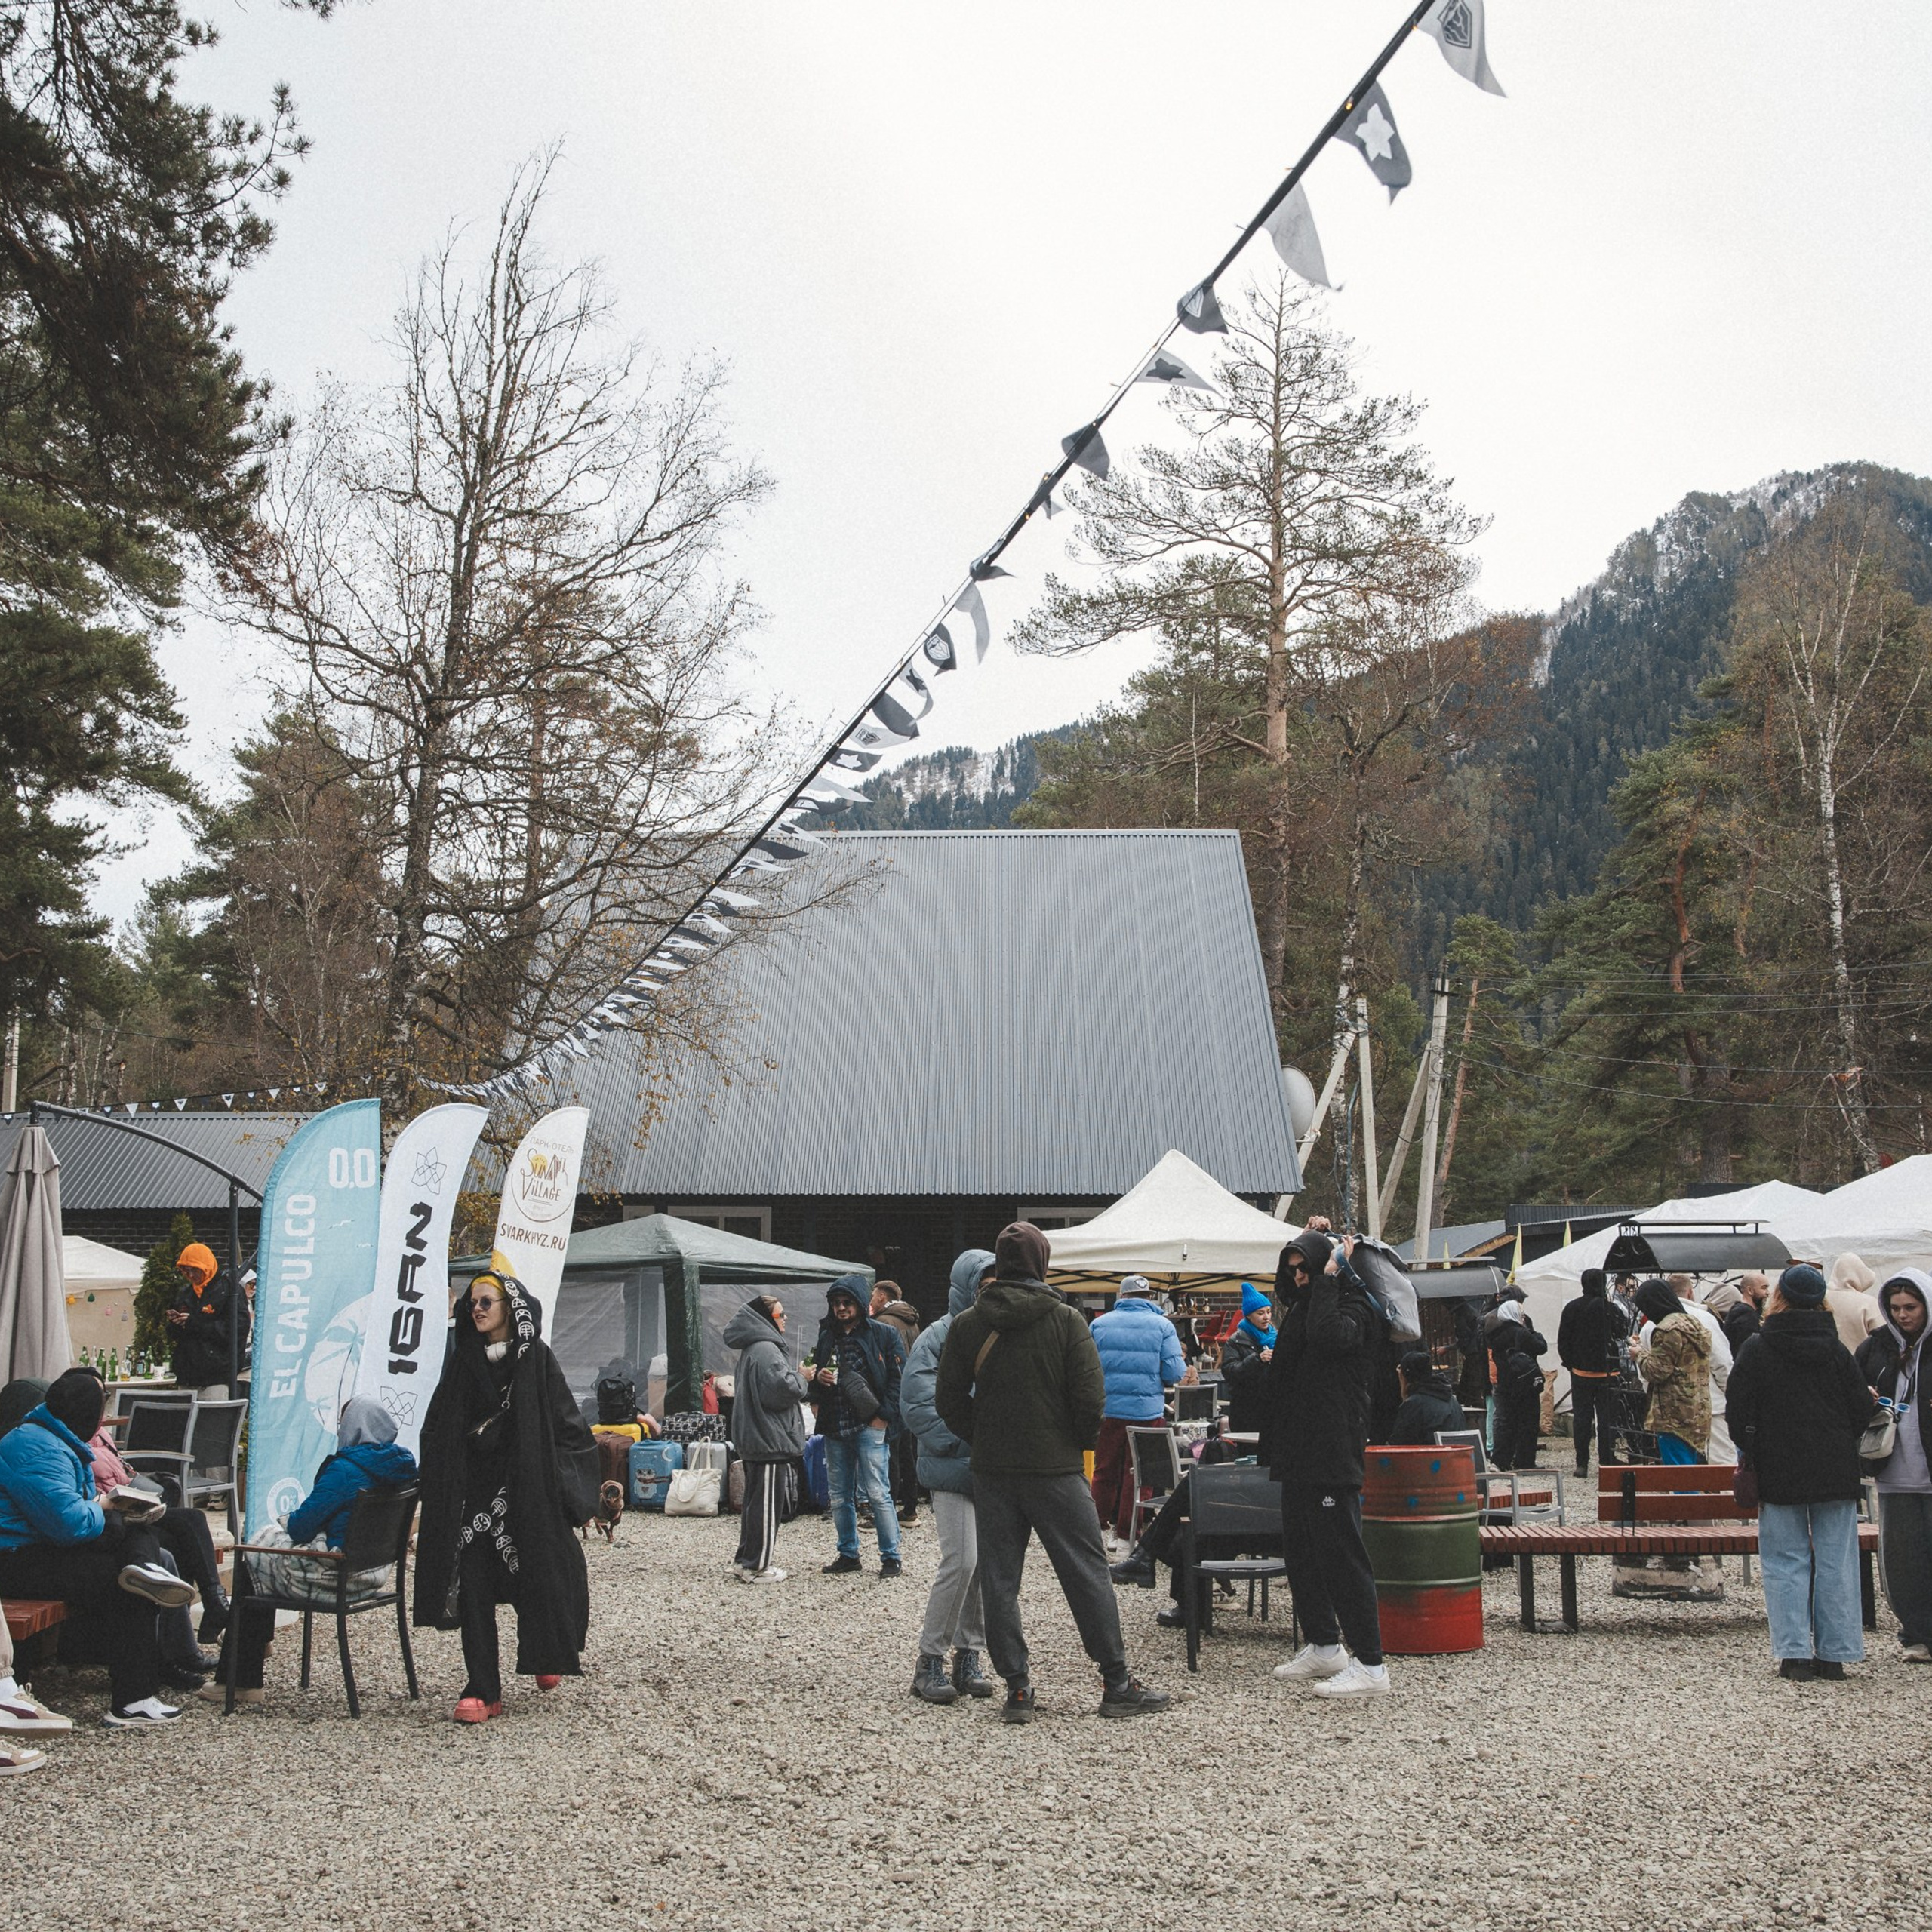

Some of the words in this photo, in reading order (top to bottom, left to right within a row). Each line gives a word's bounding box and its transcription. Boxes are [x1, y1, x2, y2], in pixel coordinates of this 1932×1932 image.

[500, 1223, 567, 1251] SVARKHYZ.RU
[275, 1194, 317, 1355] CAPULCO
[272, 1358, 303, 1398] EL
